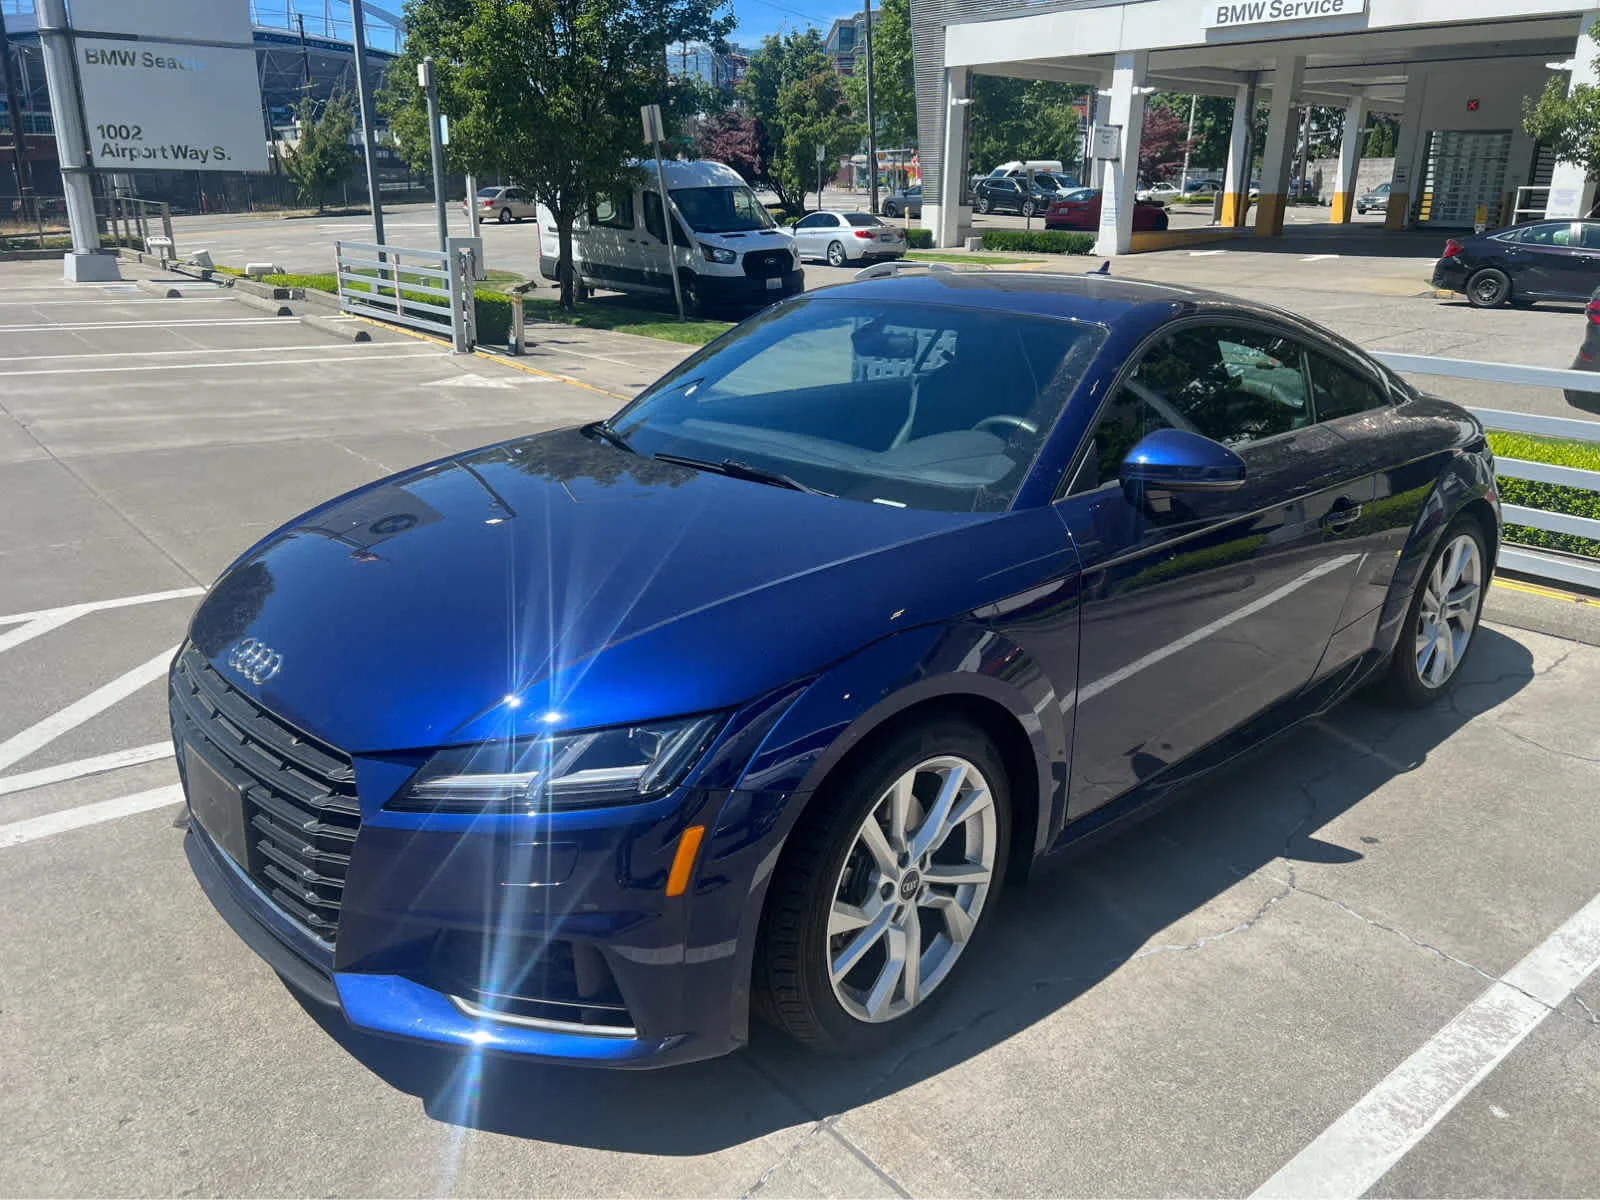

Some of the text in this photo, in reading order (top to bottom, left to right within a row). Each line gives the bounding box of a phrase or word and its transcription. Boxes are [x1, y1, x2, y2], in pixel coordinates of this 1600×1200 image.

[1216, 0, 1344, 24] BMW Service
[84, 47, 136, 66] BMW
[97, 123, 143, 141] 1002
[101, 142, 231, 163] Airport Way S.
